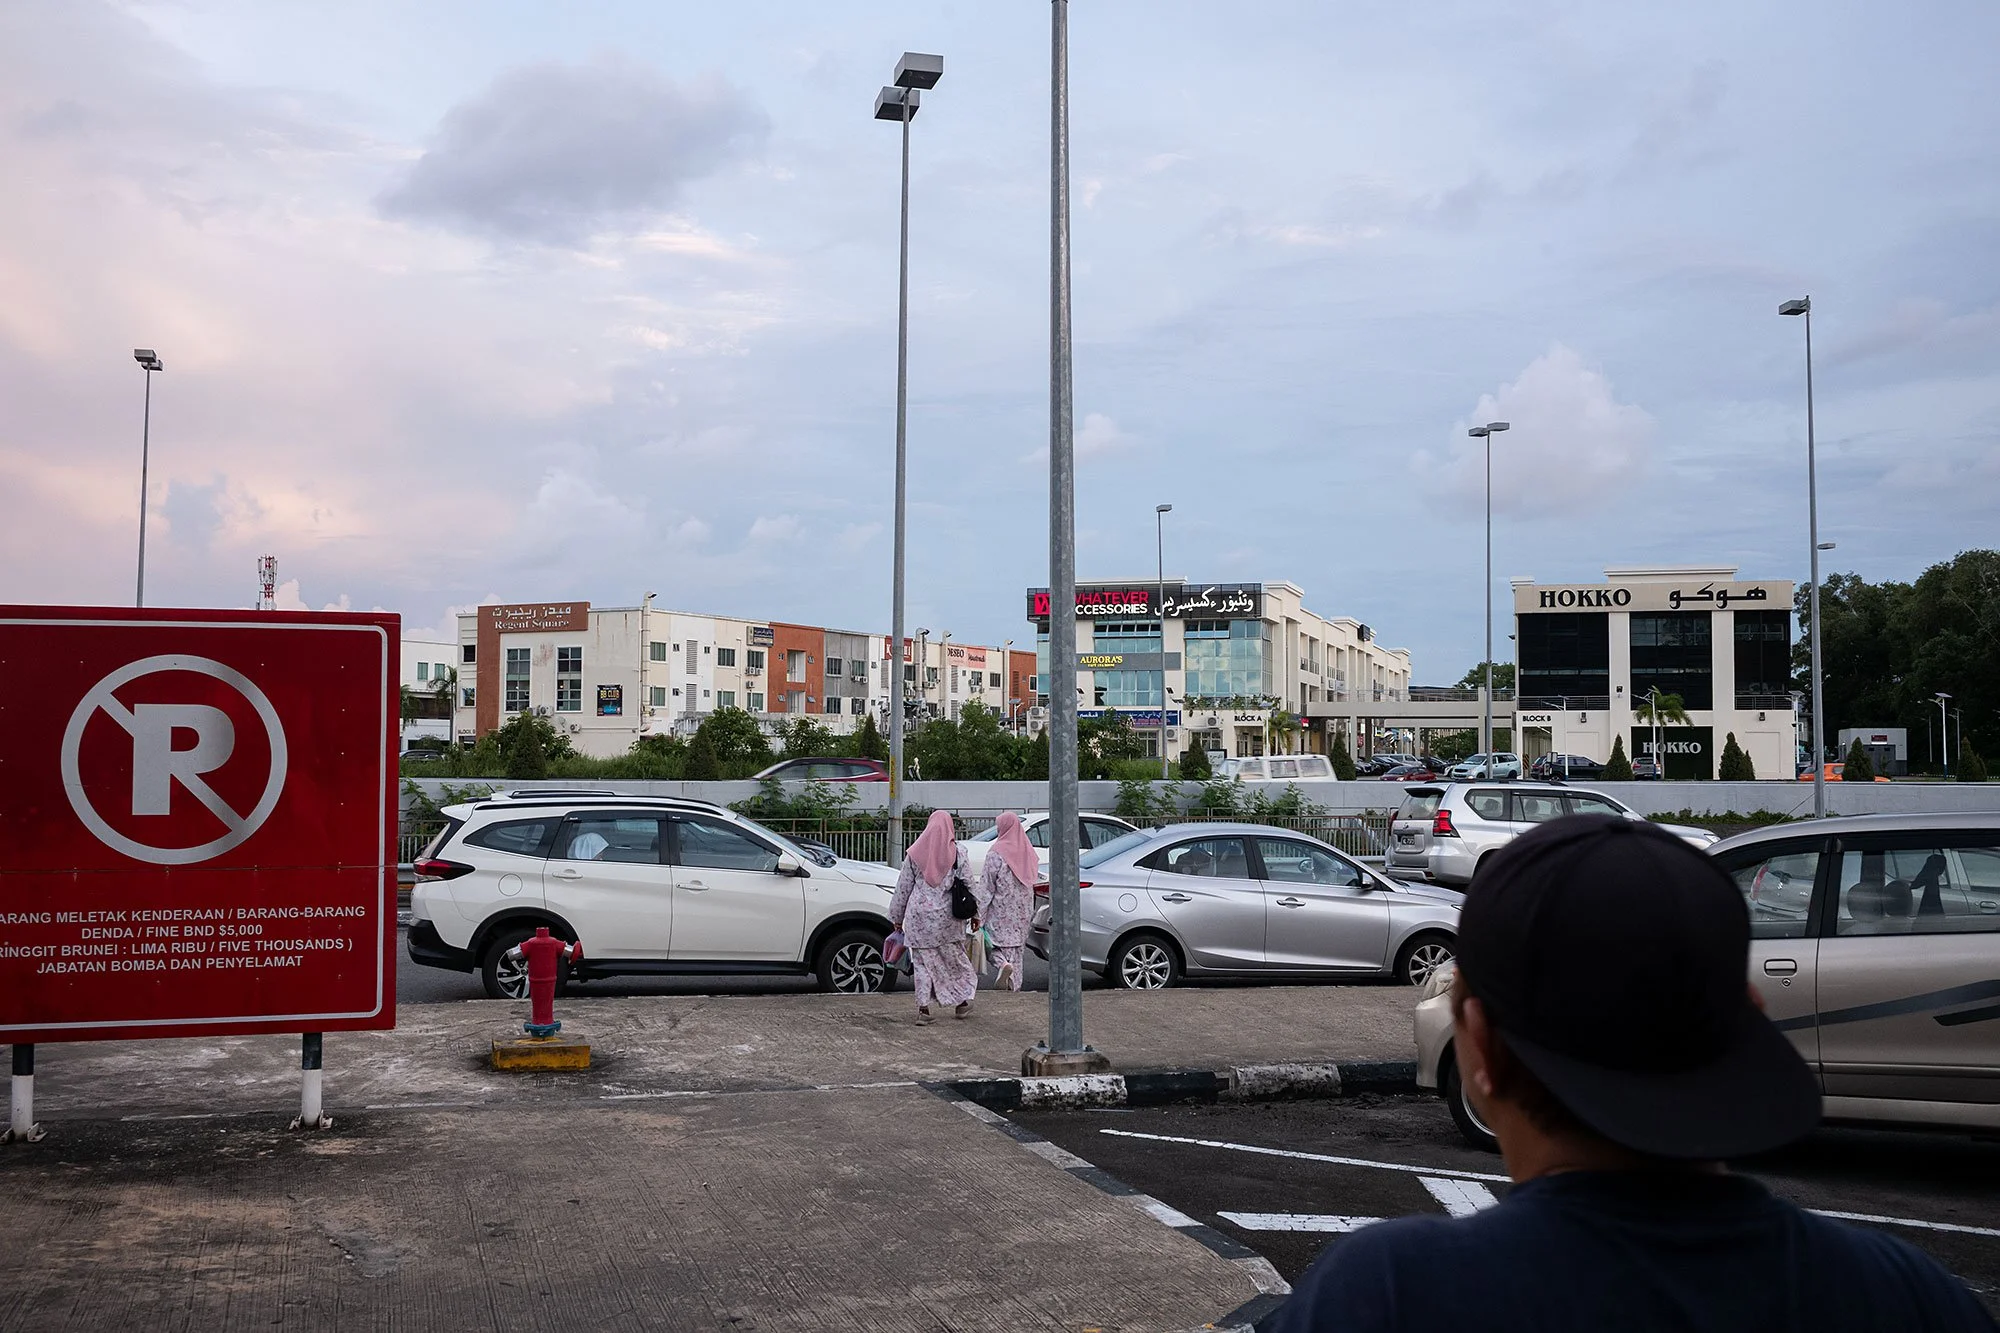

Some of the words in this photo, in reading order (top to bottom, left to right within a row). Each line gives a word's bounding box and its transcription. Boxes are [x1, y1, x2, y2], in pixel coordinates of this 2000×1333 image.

[1539, 588, 1632, 608] HOKKO
[1074, 603, 1148, 615] CCESSORIES
[494, 620, 529, 629] Regent
[532, 619, 570, 629] Square
[1080, 655, 1123, 664] AURORA'S
[1642, 741, 1702, 754] HOKKO
[56, 910, 127, 923] MELETAK
[131, 909, 224, 922] KENDERAAN
[237, 906, 366, 919] BARANG-BARANG
[81, 927, 134, 939] DENDA
[146, 926, 179, 938] FINE
[183, 925, 215, 937] BND
[218, 924, 263, 938] $5,000
[61, 944, 118, 957] BRUNEI
[131, 943, 167, 955] LIMA
[171, 942, 206, 954] RIBU
[218, 940, 250, 952] FIVE
[254, 938, 344, 951] THOUSANDS
[36, 960, 107, 974] JABATAN
[111, 959, 166, 972] BOMBA
[170, 958, 201, 970] DAN
[206, 955, 304, 969] PENYELAMAT
